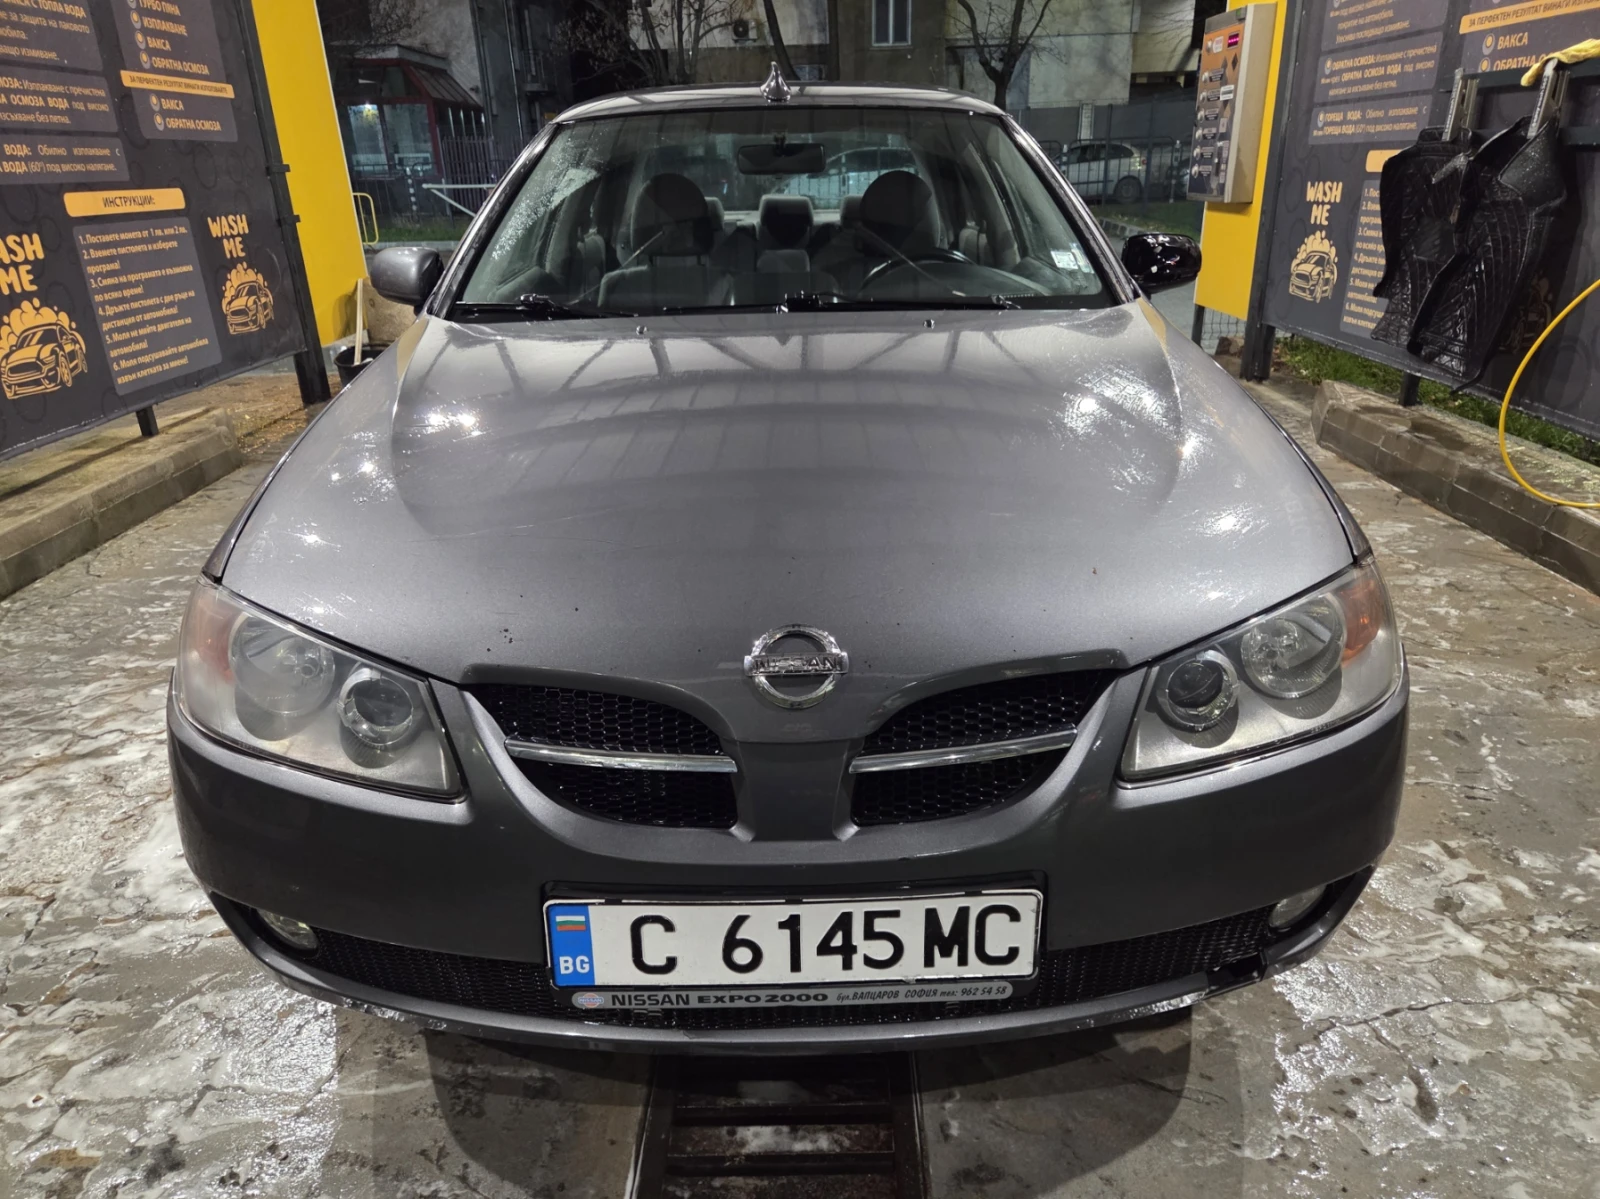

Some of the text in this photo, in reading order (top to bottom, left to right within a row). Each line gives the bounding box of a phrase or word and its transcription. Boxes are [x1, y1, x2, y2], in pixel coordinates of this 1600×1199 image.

[65, 4, 86, 19] ВОДА
[48, 19, 58, 28] на
[141, 16, 188, 36] ИЗПЛАКВАНЕ
[146, 36, 172, 51] ВАКСА
[1497, 32, 1529, 50] ВАКСА
[151, 57, 210, 75] ОБРАТНА ОСМОЗА
[10, 94, 45, 107] ОСМОЗА
[47, 97, 70, 111] ВОДА
[72, 101, 86, 111] под
[160, 98, 184, 111] ВАКСА
[35, 111, 49, 123] без
[165, 117, 222, 131] ОБРАТНА ОСМОЗА
[3, 144, 32, 157] ВОДА:
[37, 144, 67, 156] Обилно
[2, 161, 28, 175] ВОДА
[46, 163, 61, 173] под
[1305, 181, 1343, 203] WASH
[1310, 204, 1331, 226] ME
[207, 213, 249, 238] WASH
[79, 235, 86, 244] 1.
[86, 232, 119, 244] Поставете
[82, 250, 90, 259] 2.
[90, 248, 117, 258] Вземете
[222, 237, 246, 259] ME
[0, 264, 38, 295] ME
[629, 904, 1022, 975] C 6145 MC
[559, 954, 591, 975] BG
[611, 993, 690, 1006] NISSAN
[904, 988, 938, 999] СОФИЯ
[961, 987, 979, 997] 962
[980, 986, 993, 996] 54
[995, 985, 1008, 995] 58
